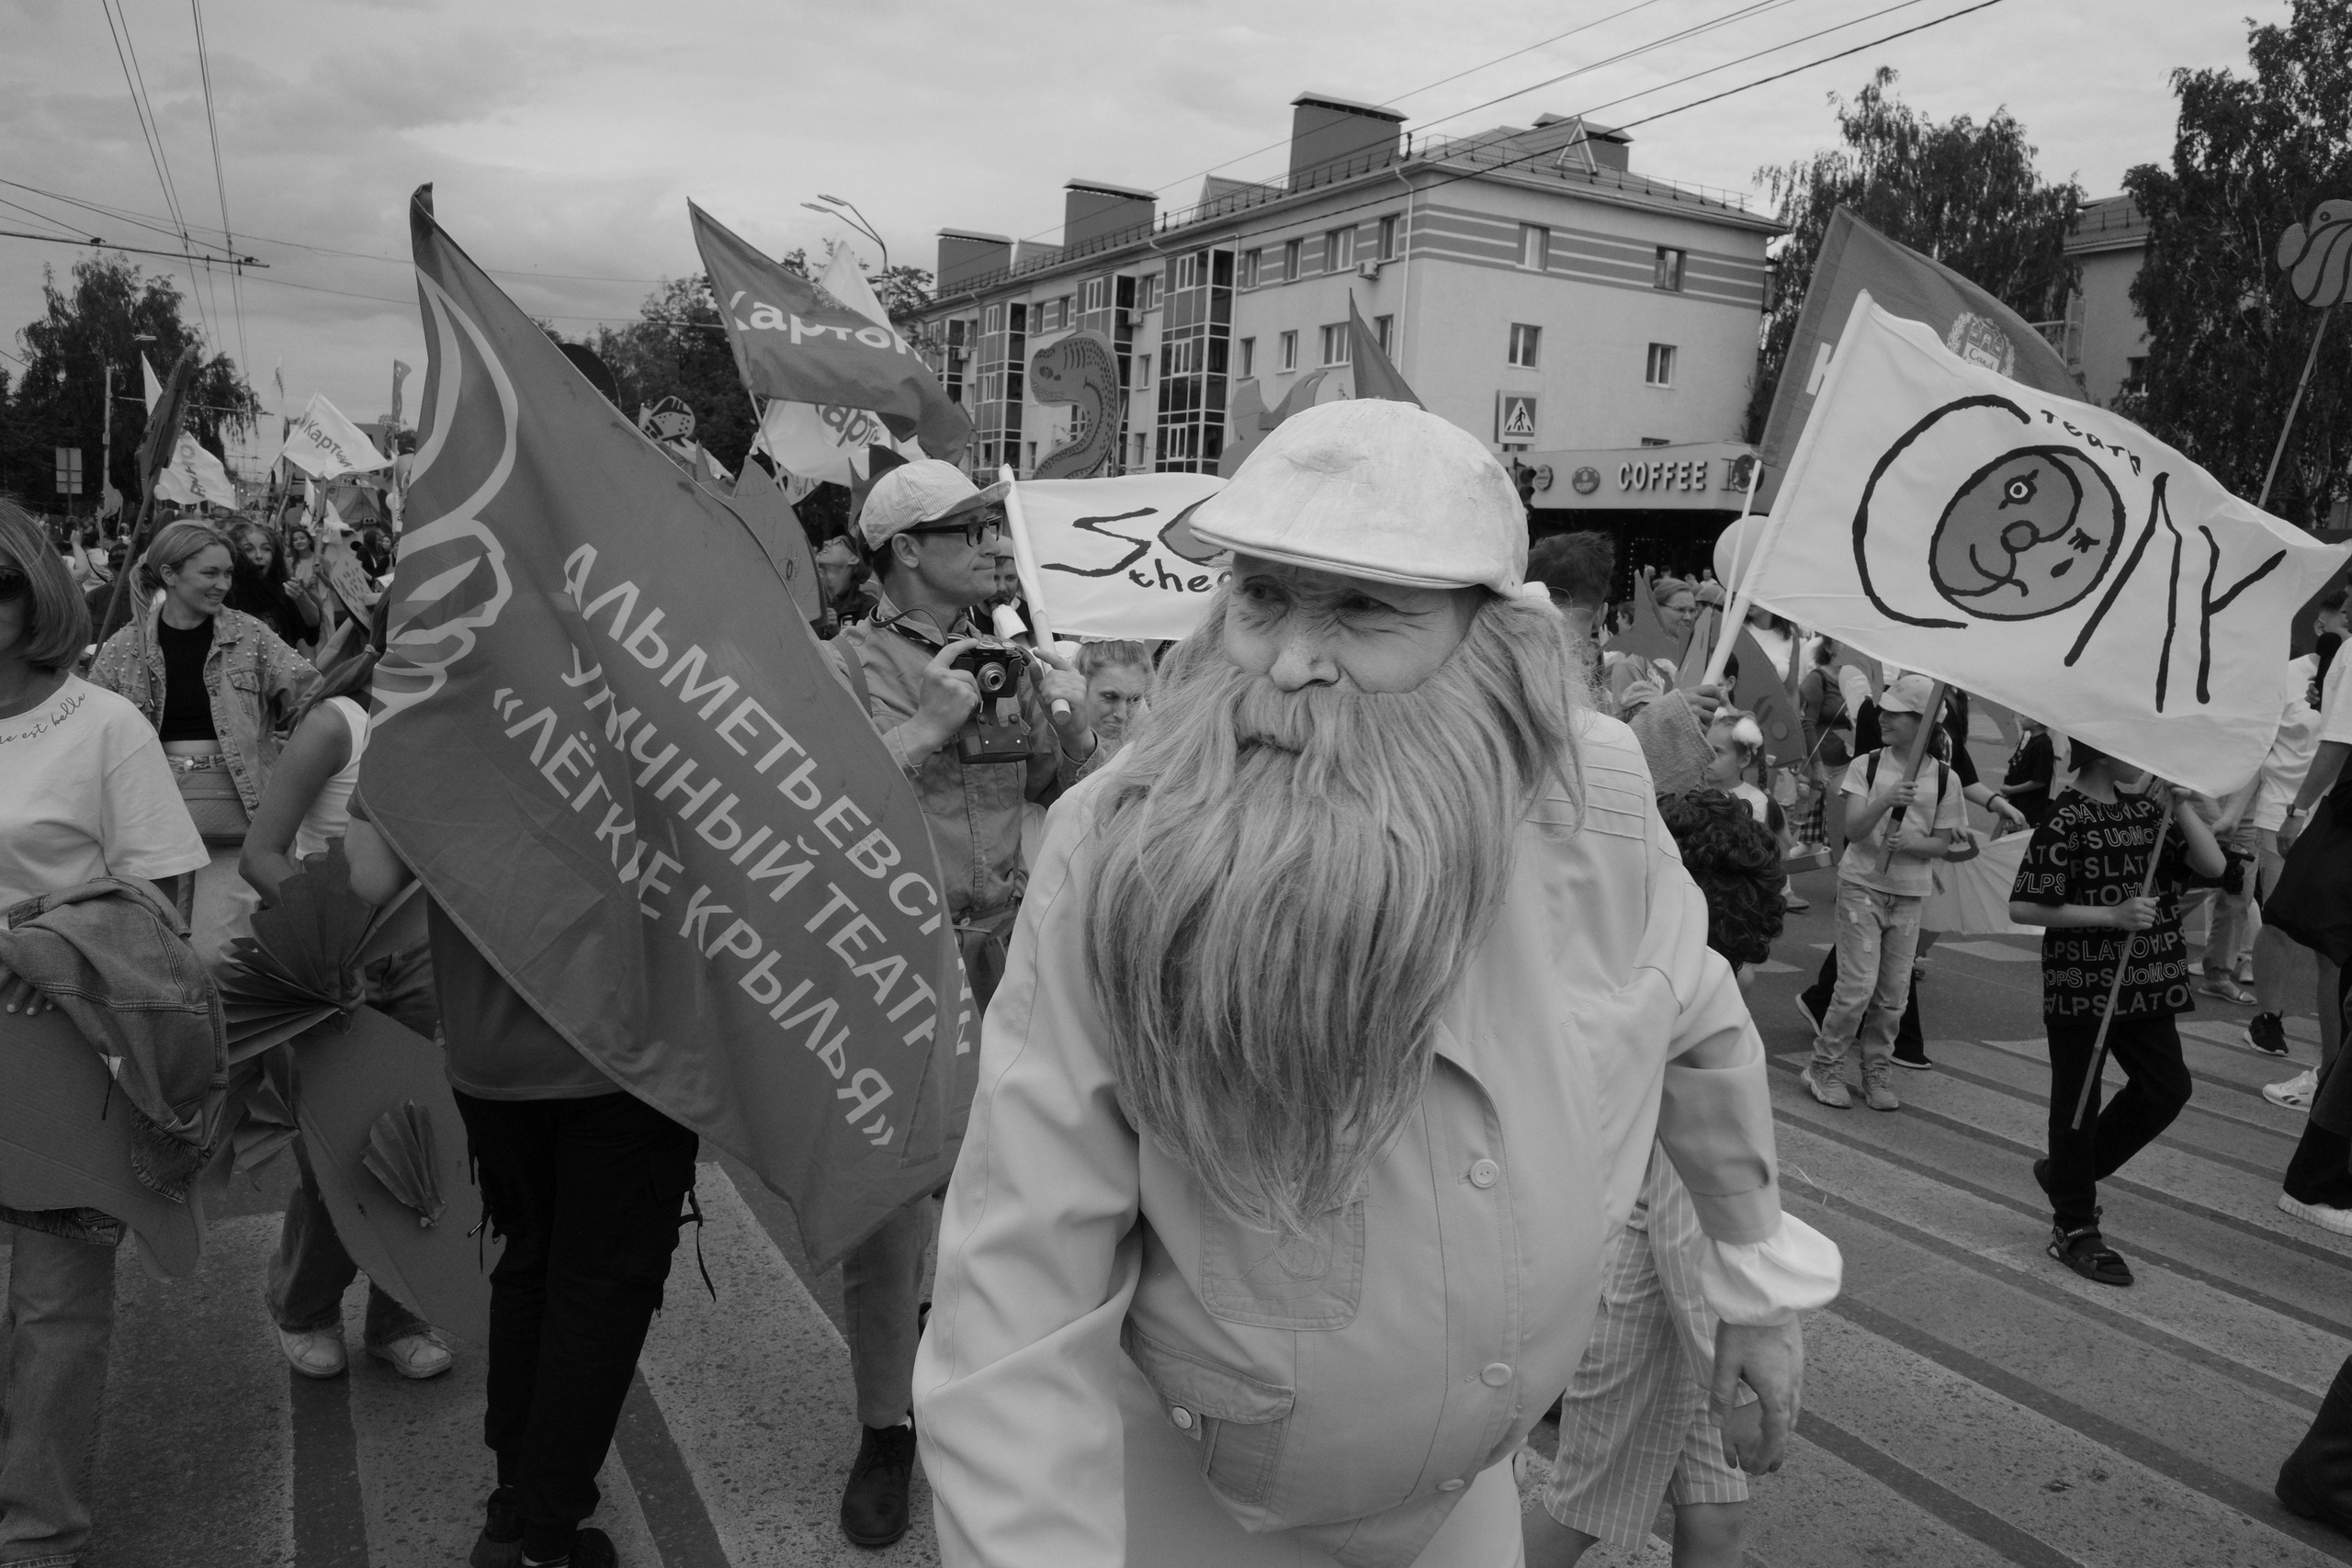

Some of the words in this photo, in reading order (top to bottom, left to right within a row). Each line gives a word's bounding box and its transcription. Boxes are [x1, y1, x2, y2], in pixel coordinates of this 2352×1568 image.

[1618, 461, 1707, 491] COFFEE
[21, 723, 48, 739] est
[51, 693, 85, 727] belle
[678, 885, 894, 1145] КРЫЛЬЯ»
